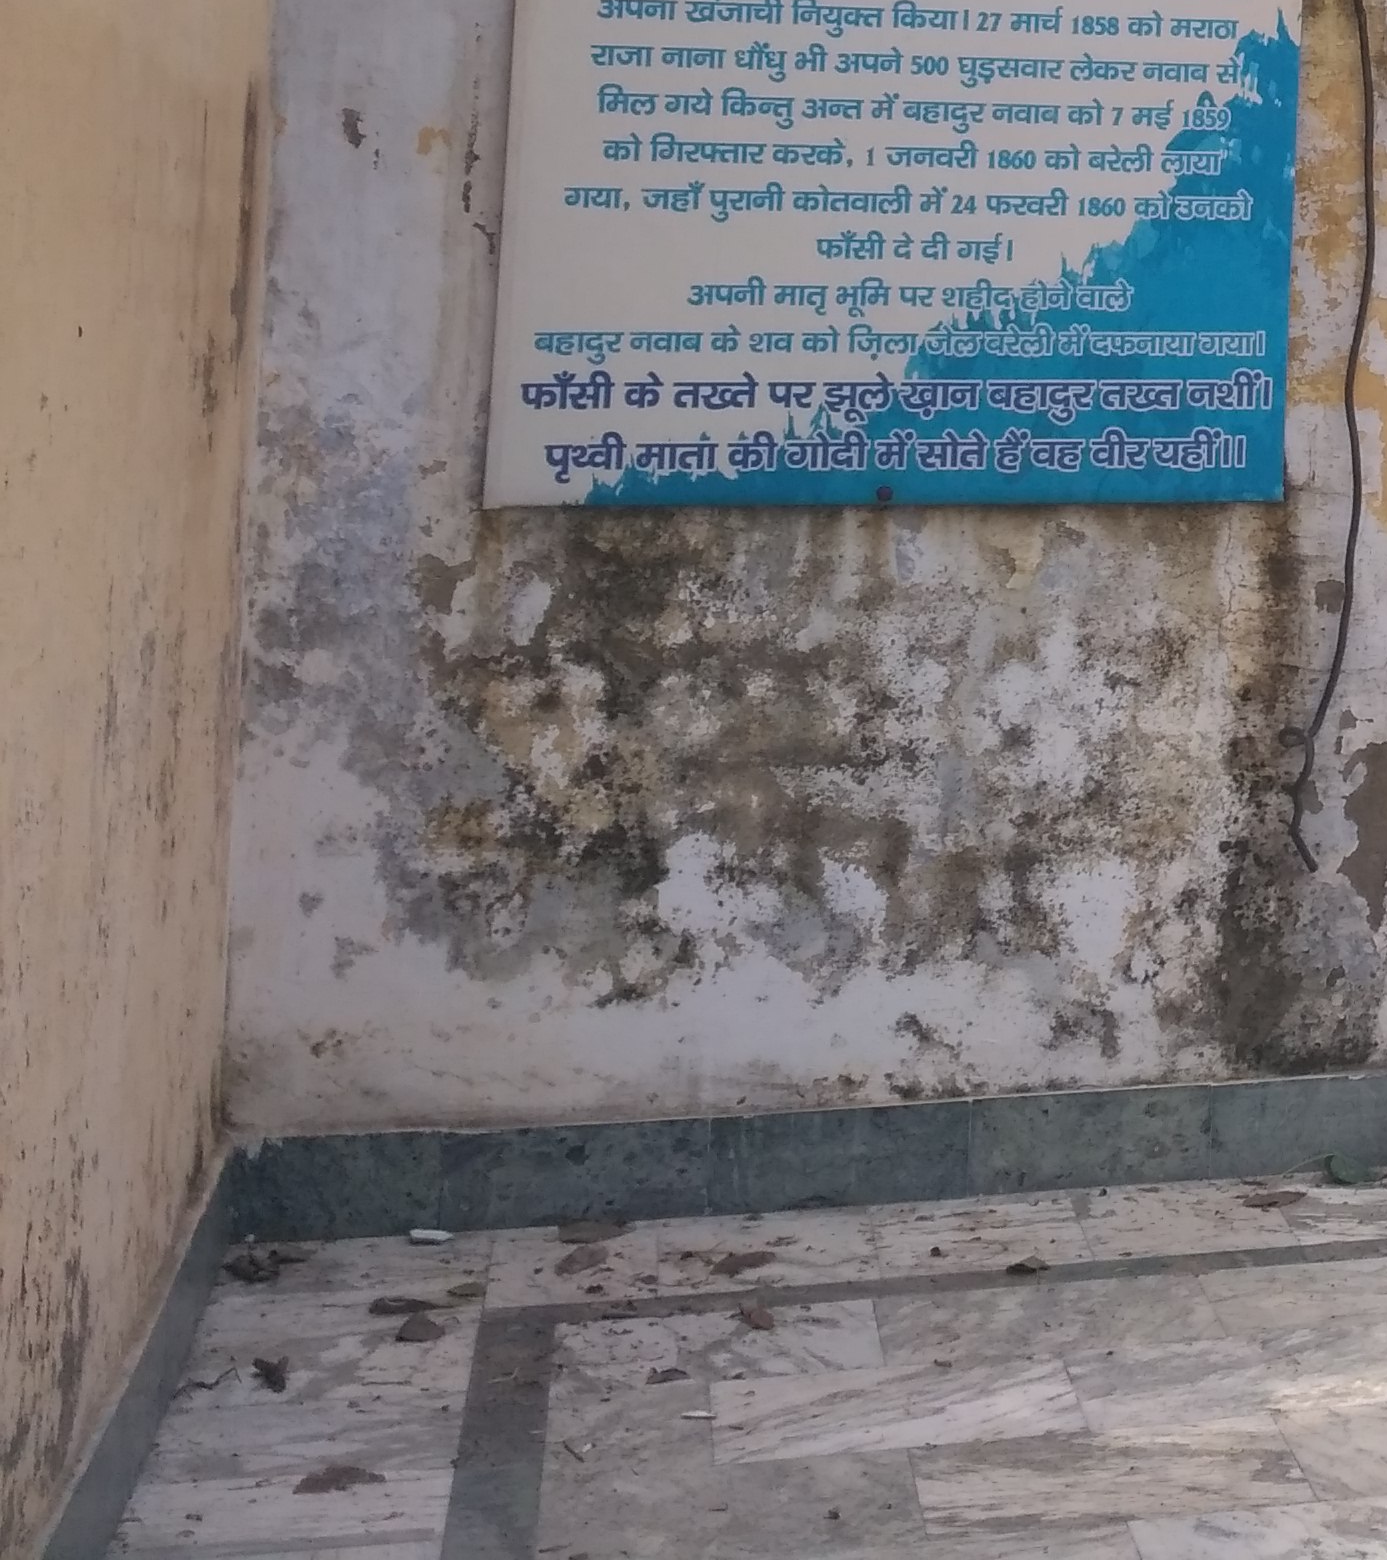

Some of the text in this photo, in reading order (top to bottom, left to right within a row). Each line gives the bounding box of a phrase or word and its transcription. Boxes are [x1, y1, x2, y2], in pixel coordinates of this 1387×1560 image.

[975, 10, 1003, 32] 27
[1009, 4, 1064, 34] मार्च
[1070, 14, 1120, 36] 1858
[1126, 8, 1164, 38] को
[1169, 17, 1240, 42] मराठा
[589, 44, 655, 67] राजा
[659, 46, 727, 69] नाना
[793, 41, 829, 72] भी
[833, 45, 905, 74] अपने
[909, 54, 950, 76] 500
[956, 55, 1065, 88] घुड़सवार
[1068, 51, 1139, 82] लेकर
[1141, 61, 1211, 83] नवाब
[1215, 55, 1241, 84] से
[602, 131, 1226, 178] को गिरफ्तार करके, 1 जनवरी 1860 को बरेली लाया
[815, 228, 887, 260] फाँसी
[891, 230, 915, 260] दे
[919, 230, 951, 261] दी
[686, 274, 1136, 318] अपनी मातृ भूमि पर शहीद होने वाले
[519, 369, 616, 410] फाँसी
[623, 370, 665, 409] के
[671, 370, 760, 410] तख्ते
[764, 380, 818, 411] पर
[820, 368, 896, 426] झूले
[896, 378, 983, 422] ख़ान
[984, 378, 1099, 425] बहादुर
[1097, 377, 1185, 412] तख्त
[545, 431, 625, 484] पृथ्वी
[632, 440, 720, 473] माता
[725, 428, 779, 473] की
[782, 429, 871, 472] गोदी
[871, 428, 916, 471] में
[913, 427, 990, 472] सोते
[991, 425, 1031, 475] हैं
[1027, 433, 1086, 475] वह
[1088, 424, 1151, 471] वीर
